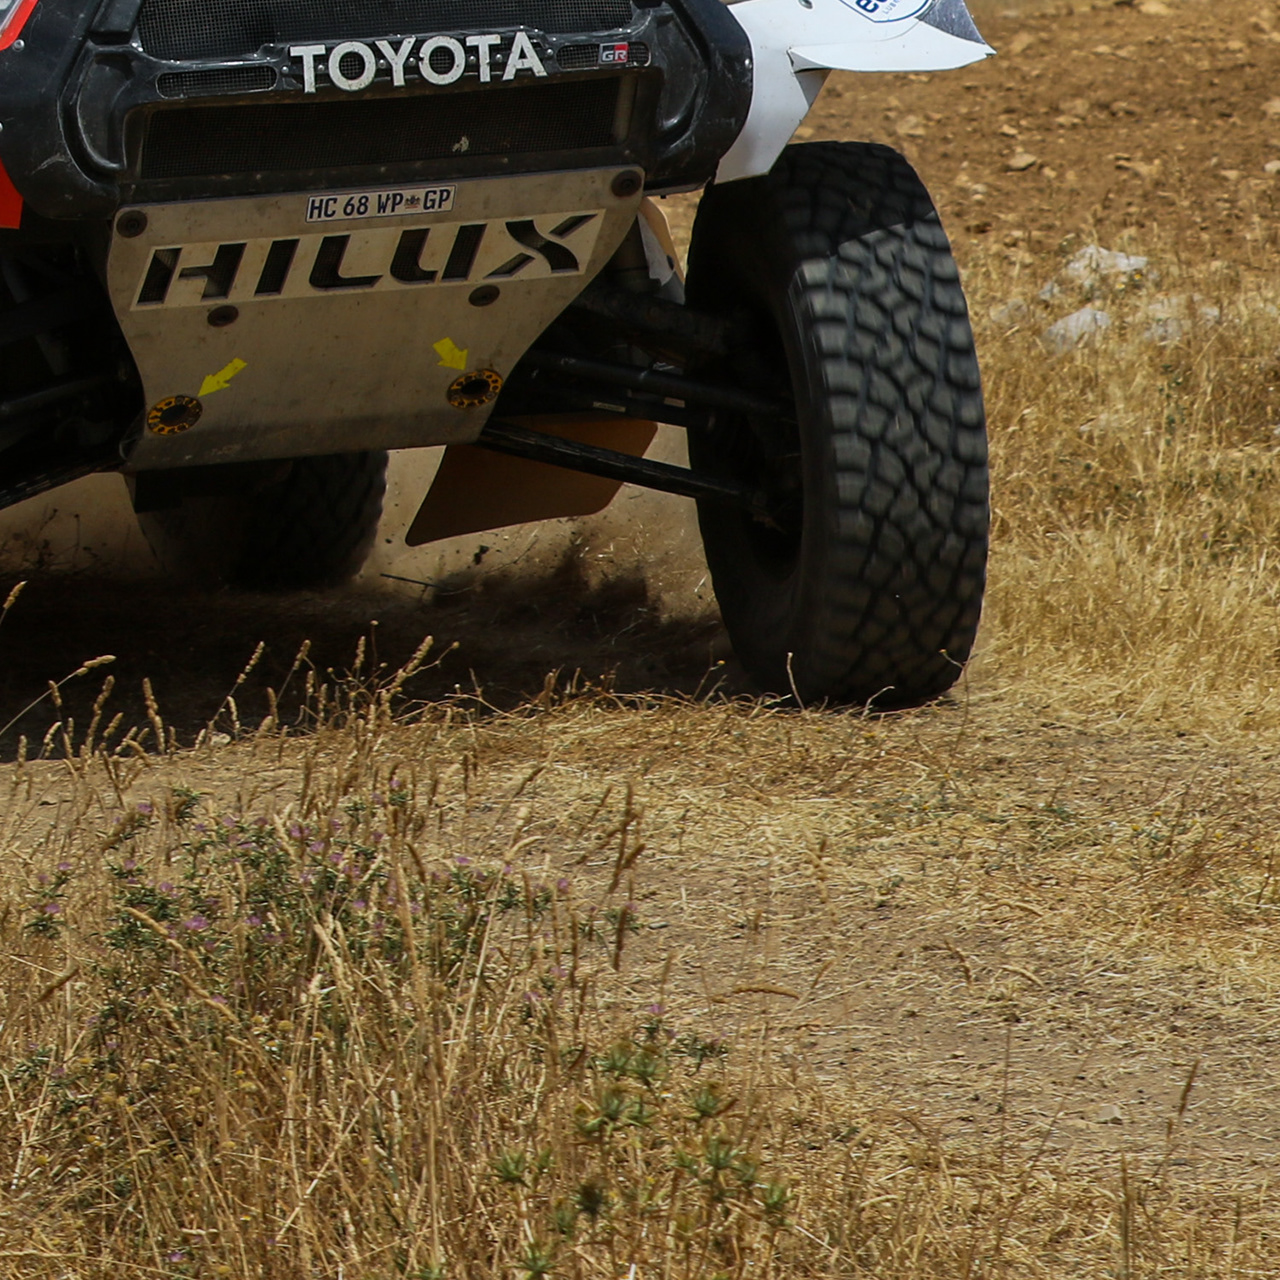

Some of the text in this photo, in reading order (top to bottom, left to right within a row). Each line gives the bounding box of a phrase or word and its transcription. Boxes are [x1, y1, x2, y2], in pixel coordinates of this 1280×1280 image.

[289, 31, 548, 94] TOYOTA
[602, 50, 627, 63] GR
[309, 189, 451, 220] HC 68 WP GP
[136, 213, 599, 306] HILUX
